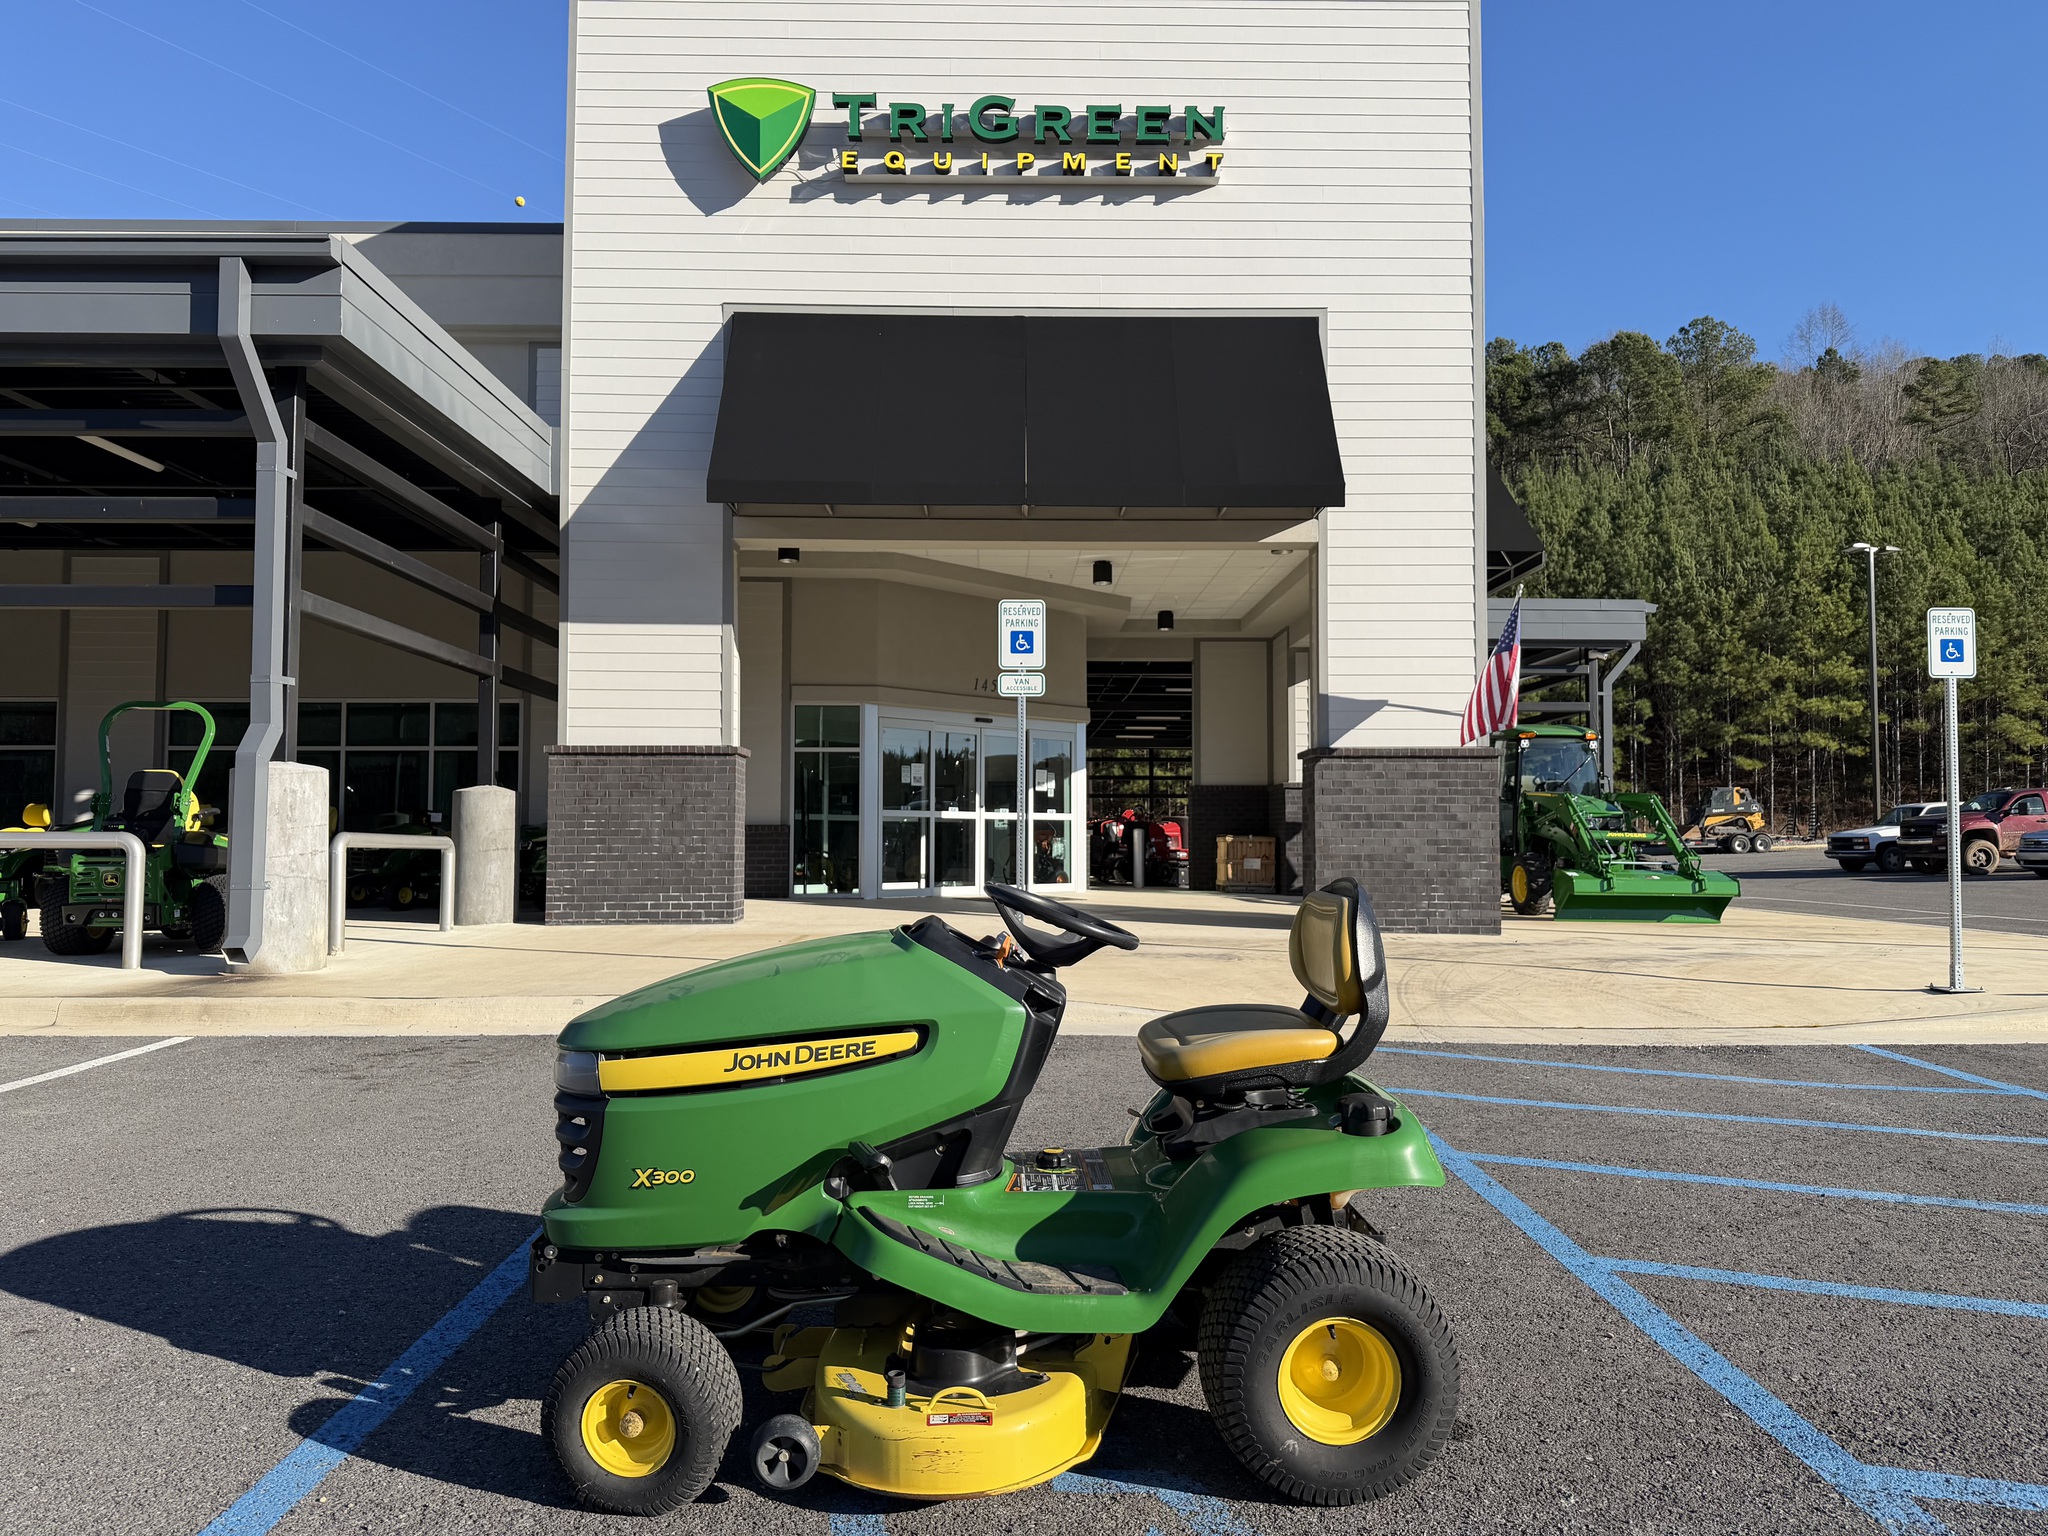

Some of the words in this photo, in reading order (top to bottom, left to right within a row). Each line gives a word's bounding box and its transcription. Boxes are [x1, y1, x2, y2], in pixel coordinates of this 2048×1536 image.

[842, 150, 1223, 175] EQUIPMENT
[1003, 607, 1041, 616] RESERVED
[1005, 618, 1039, 628] PARKING
[1932, 615, 1971, 624] RESERVED
[1934, 627, 1969, 636] PARKING
[724, 1050, 790, 1073] JOHN
[794, 1040, 876, 1065] DEERE
[631, 1167, 696, 1190] X300
[1256, 1294, 1357, 1368] CARLISLE
[1402, 1398, 1432, 1452] MULTI
